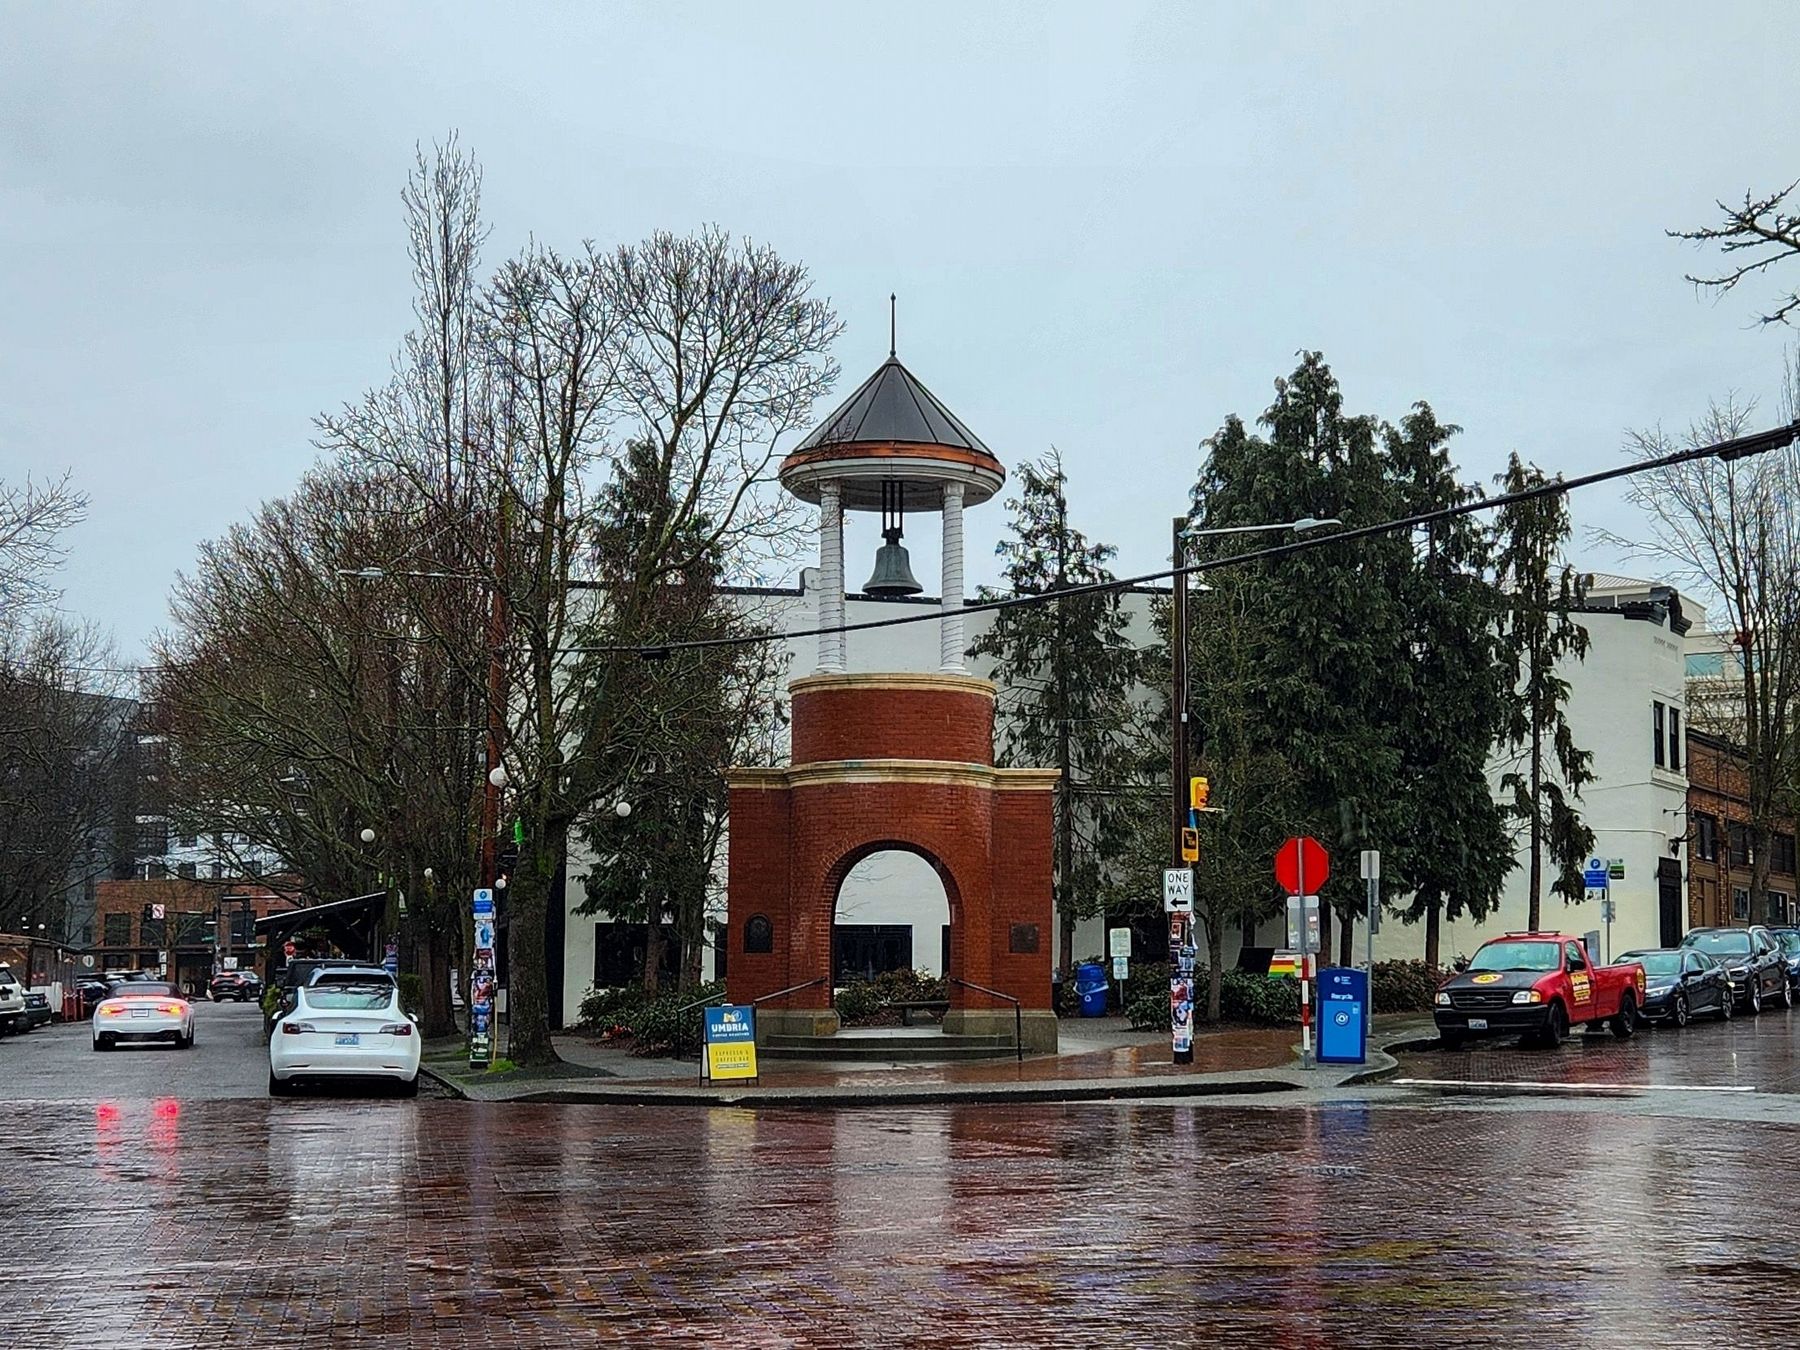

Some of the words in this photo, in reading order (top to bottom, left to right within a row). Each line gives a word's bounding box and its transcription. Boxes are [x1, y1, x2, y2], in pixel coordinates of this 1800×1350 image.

[1168, 873, 1189, 883] ONE
[1168, 885, 1189, 895] WAY
[711, 1022, 749, 1032] UMBRIA
